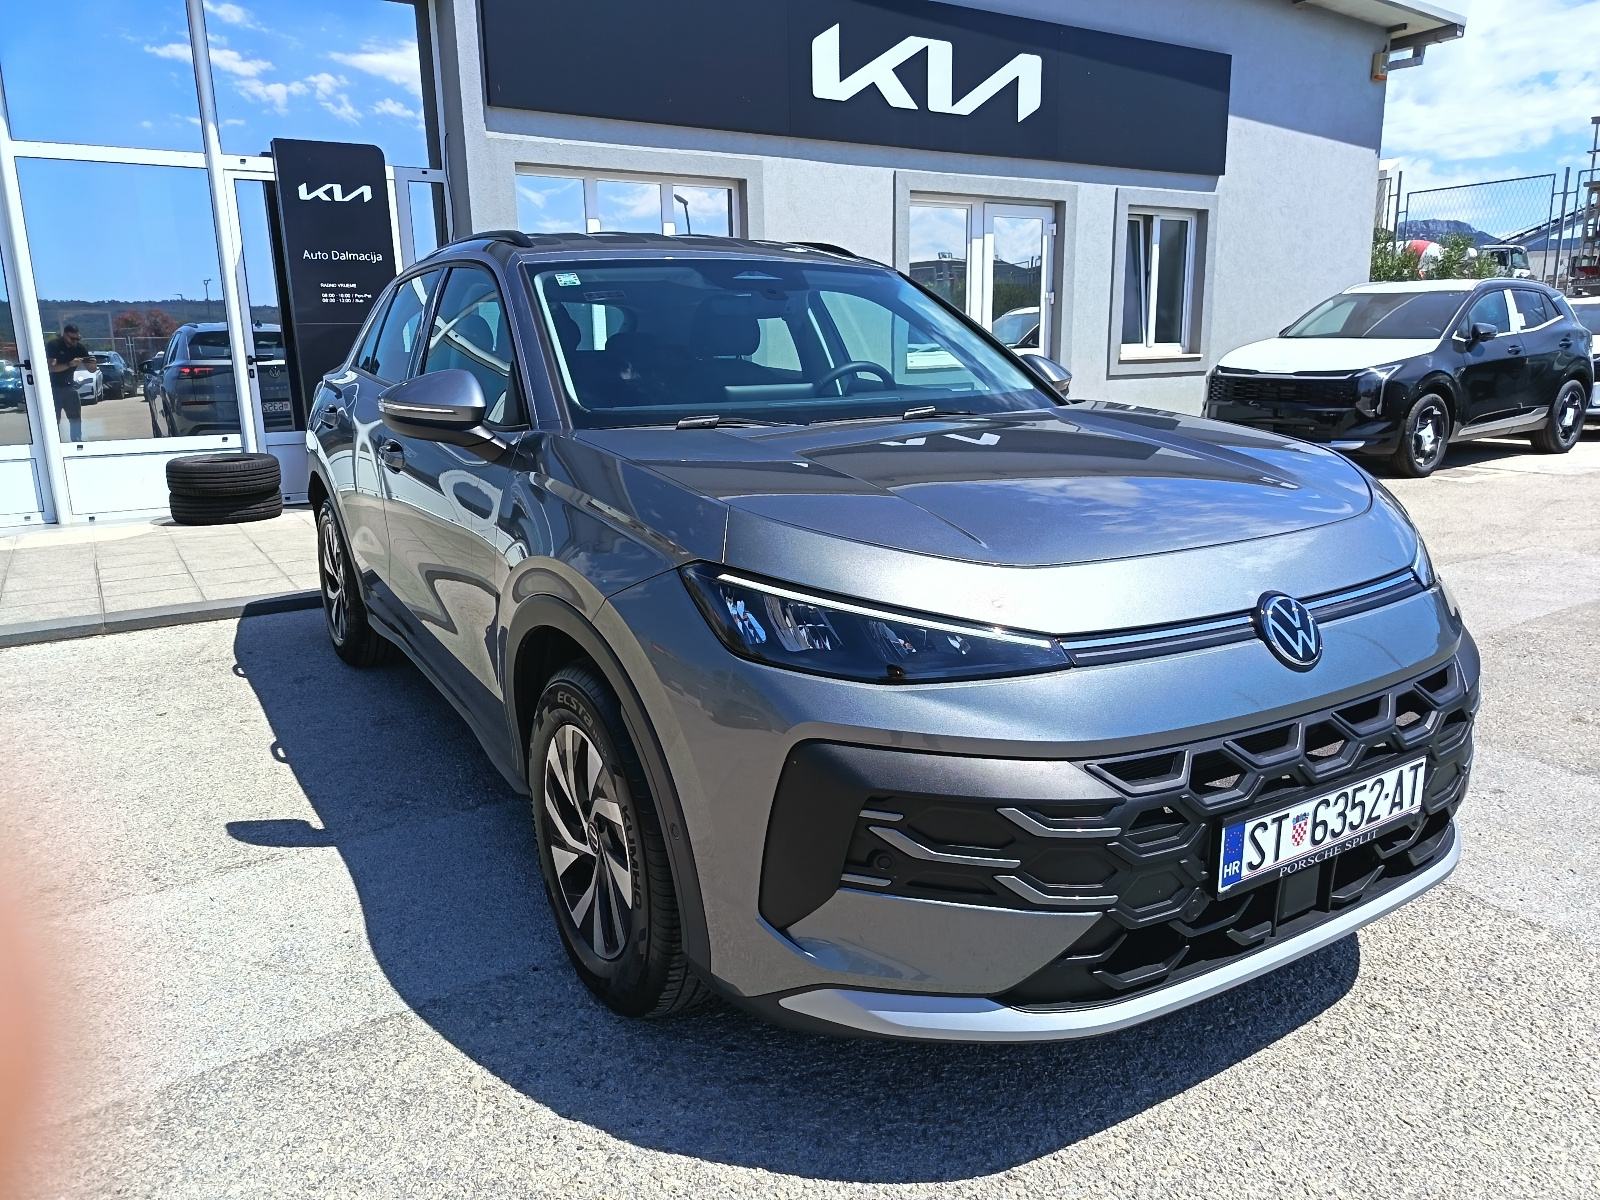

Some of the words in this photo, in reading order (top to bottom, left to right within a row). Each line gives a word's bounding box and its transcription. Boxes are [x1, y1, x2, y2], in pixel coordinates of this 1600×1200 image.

[811, 22, 1042, 123] KIA
[298, 182, 372, 203] KIA
[303, 249, 329, 261] Auto
[331, 250, 383, 264] Dalmacija
[621, 804, 642, 910] KUMHO
[1247, 812, 1290, 871] ST
[1279, 844, 1342, 877] PORSCHE
[1344, 829, 1379, 851] SPLIT
[1223, 860, 1240, 879] HR
